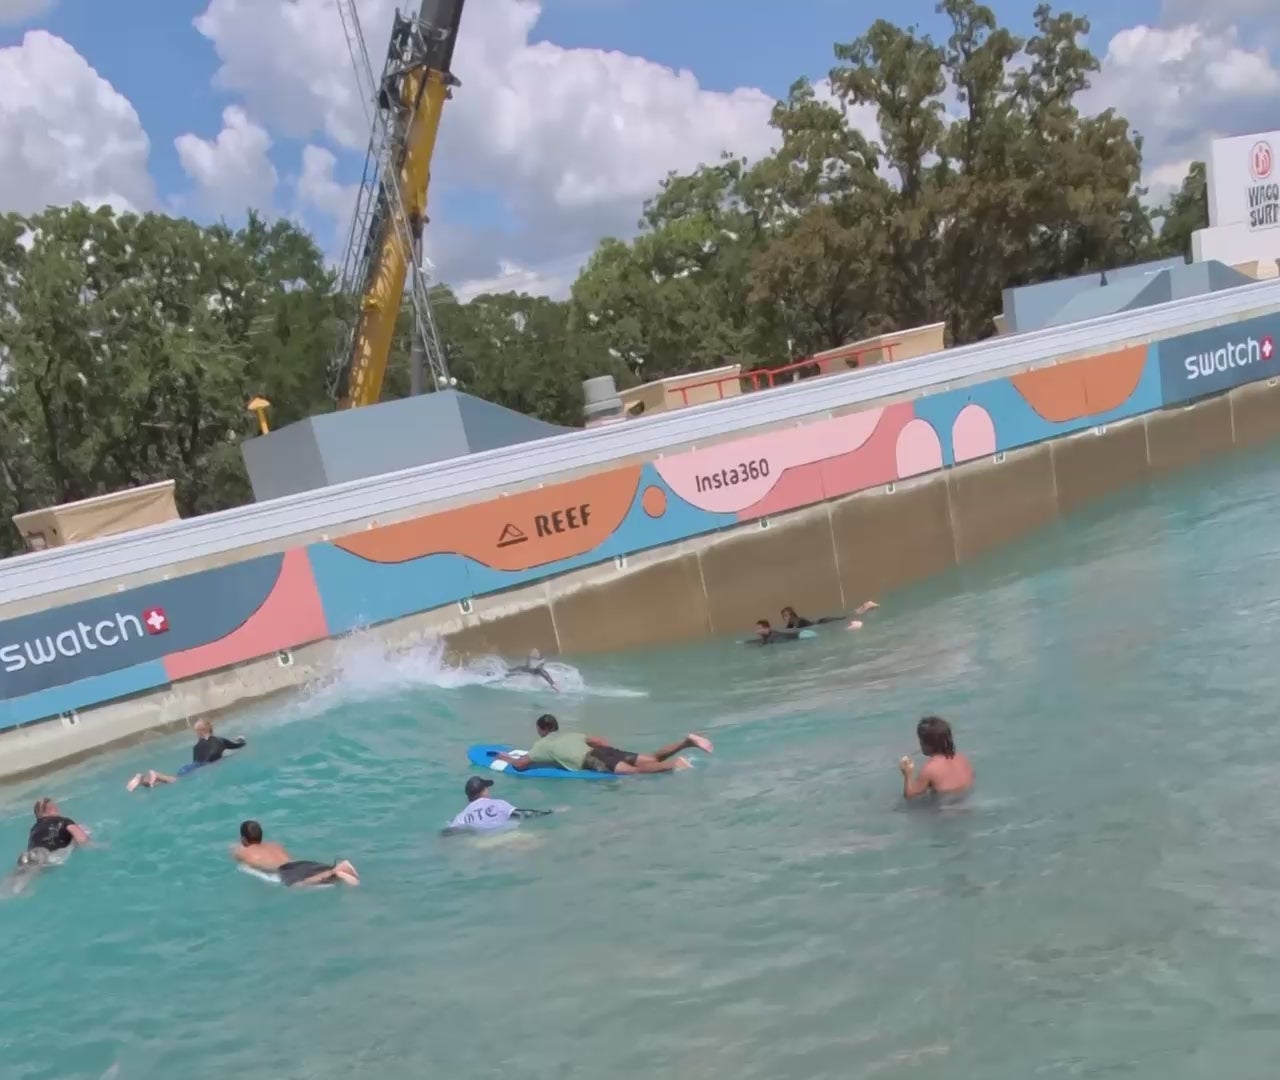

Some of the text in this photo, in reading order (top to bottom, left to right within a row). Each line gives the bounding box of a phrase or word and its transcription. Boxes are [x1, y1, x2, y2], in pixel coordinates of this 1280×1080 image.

[1184, 336, 1260, 380] swatch
[695, 458, 769, 493] Insta360
[535, 504, 591, 537] REEF
[0, 612, 144, 672] swatch
